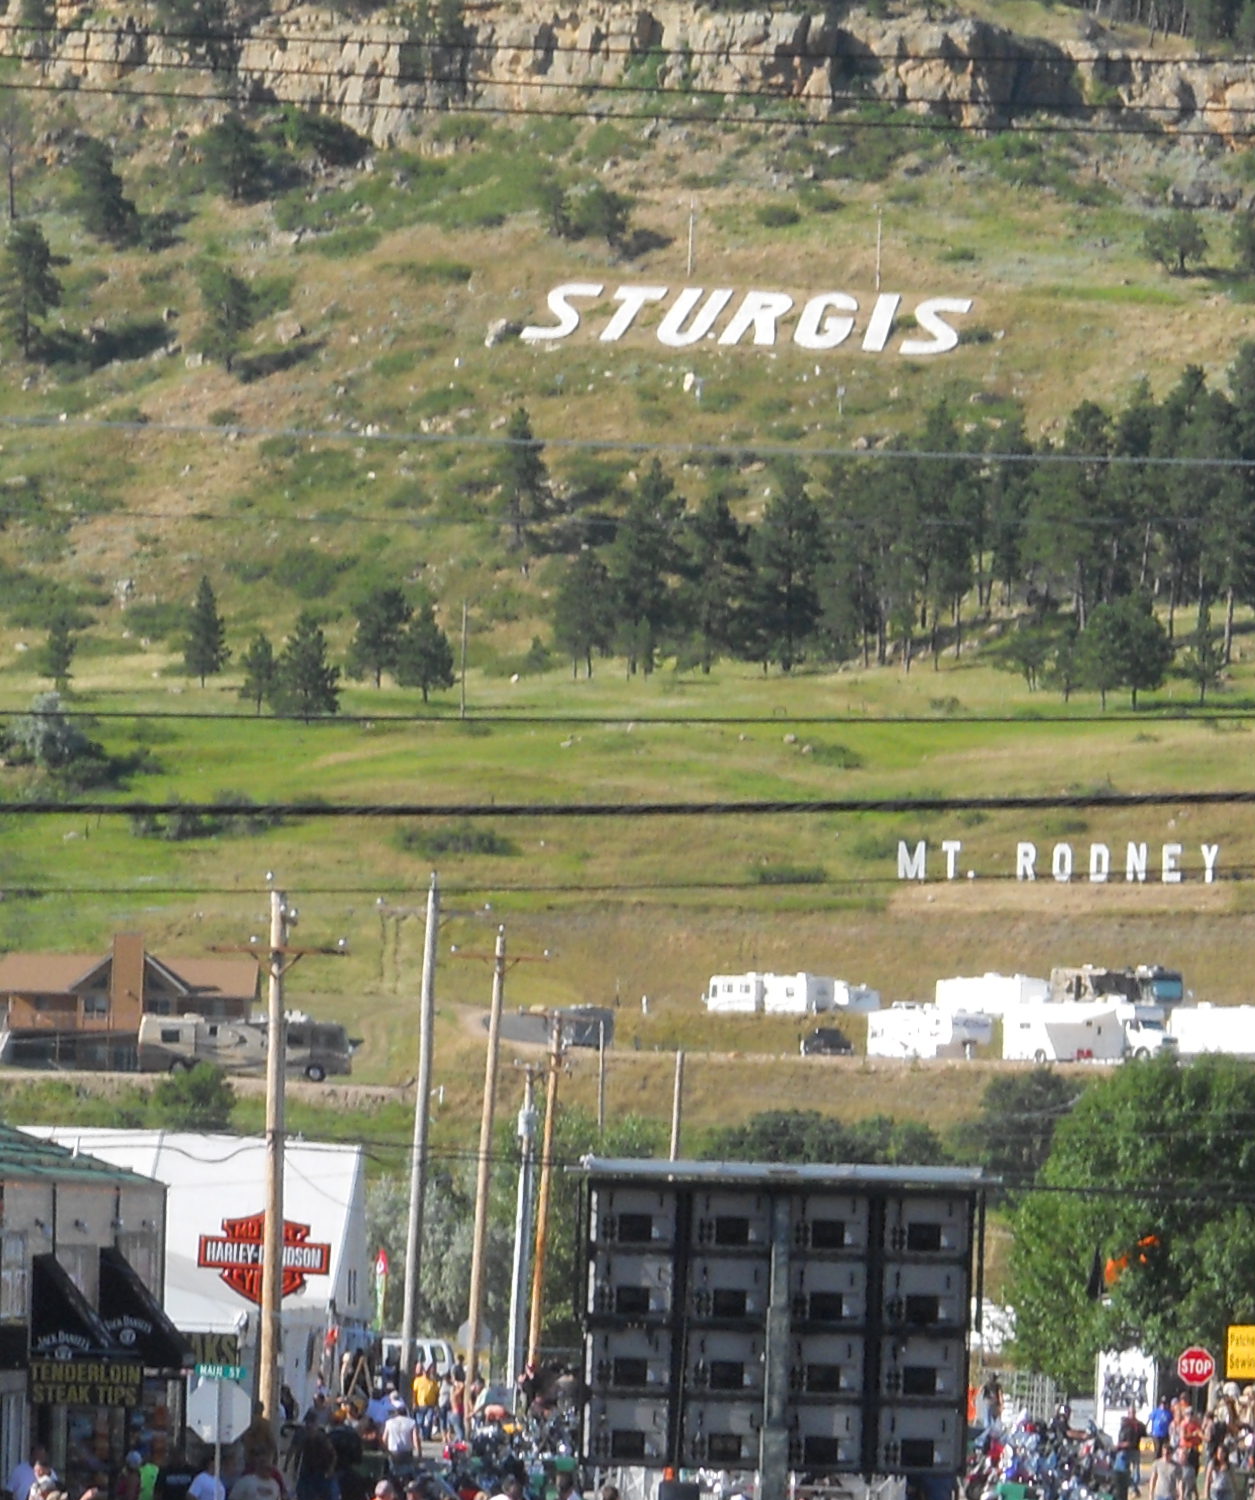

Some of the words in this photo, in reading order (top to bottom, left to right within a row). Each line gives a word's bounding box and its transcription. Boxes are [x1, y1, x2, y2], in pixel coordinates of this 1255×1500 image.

[519, 283, 974, 355] STURGIS
[897, 840, 975, 880] MT.
[1016, 841, 1220, 884] RODNEY
[31, 1362, 140, 1385] TENDERLOIN
[200, 1364, 223, 1376] MAIN
[1181, 1361, 1211, 1374] STOP
[33, 1385, 90, 1404] STEAK
[98, 1385, 137, 1405] TIPS
